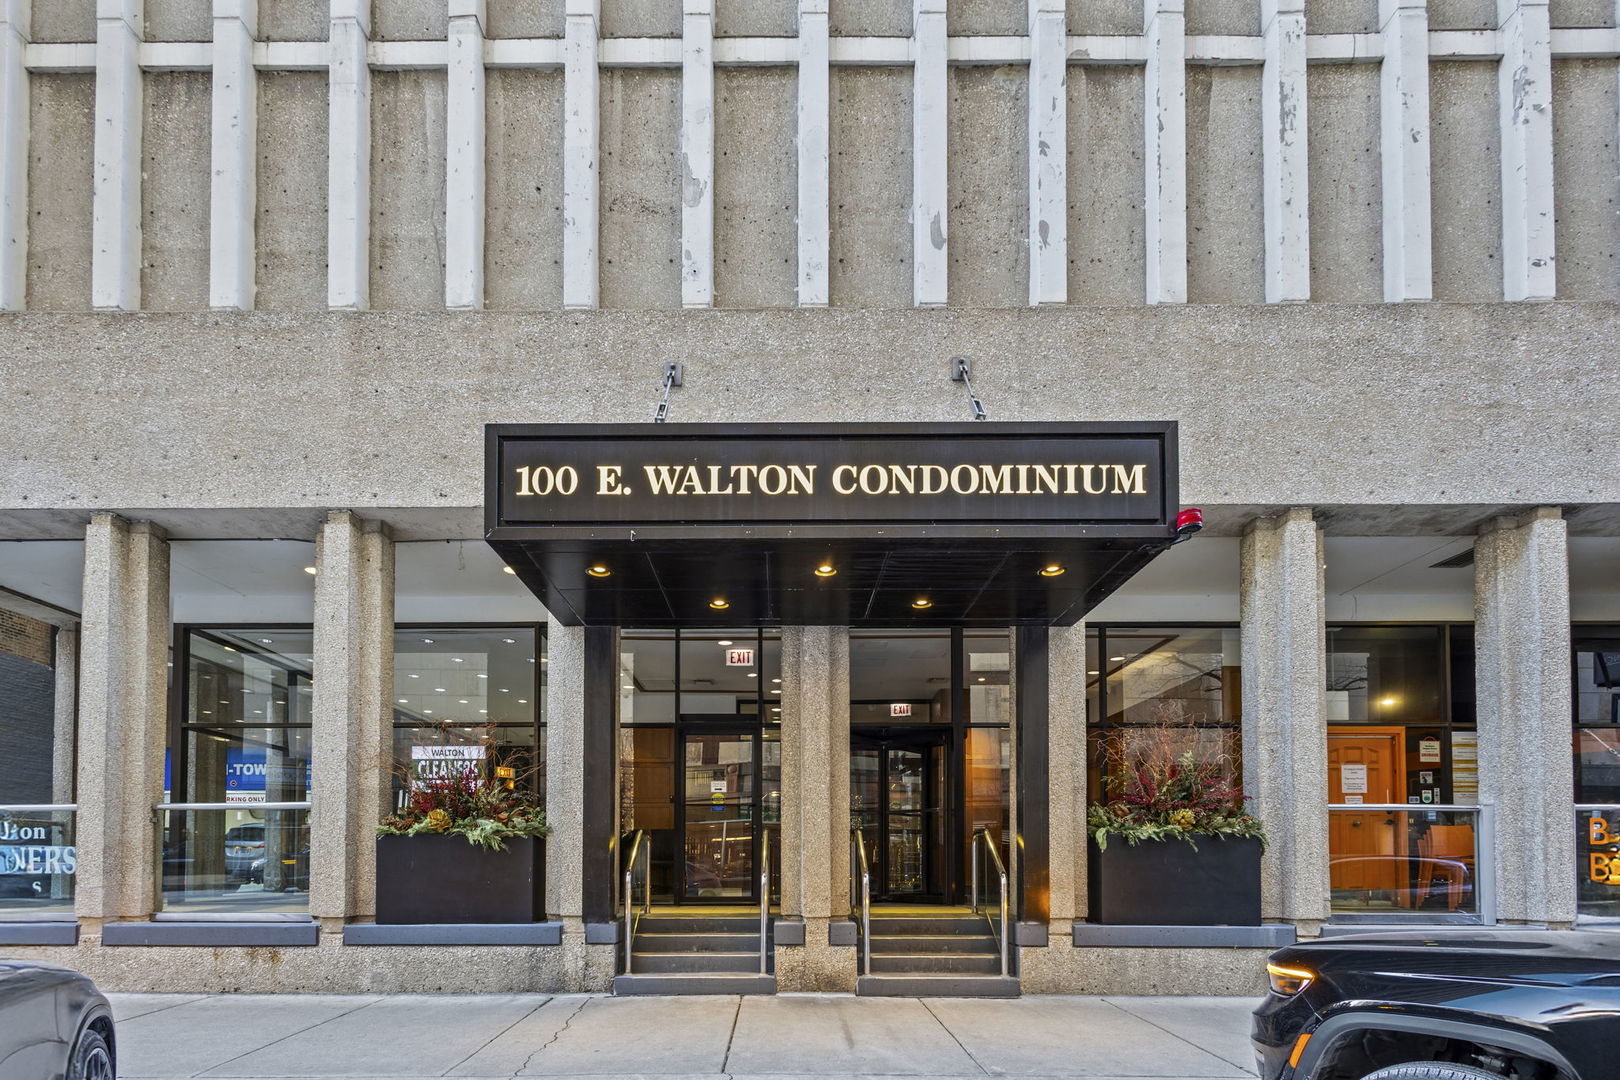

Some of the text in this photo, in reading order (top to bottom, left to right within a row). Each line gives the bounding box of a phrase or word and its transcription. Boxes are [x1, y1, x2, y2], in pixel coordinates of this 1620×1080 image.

[515, 464, 1147, 496] 100 E. WALTON CONDOMINIUM
[730, 651, 751, 664] EXIT
[893, 705, 910, 715] EXIT
[431, 749, 465, 757] WALTON
[226, 763, 267, 776] -TOW
